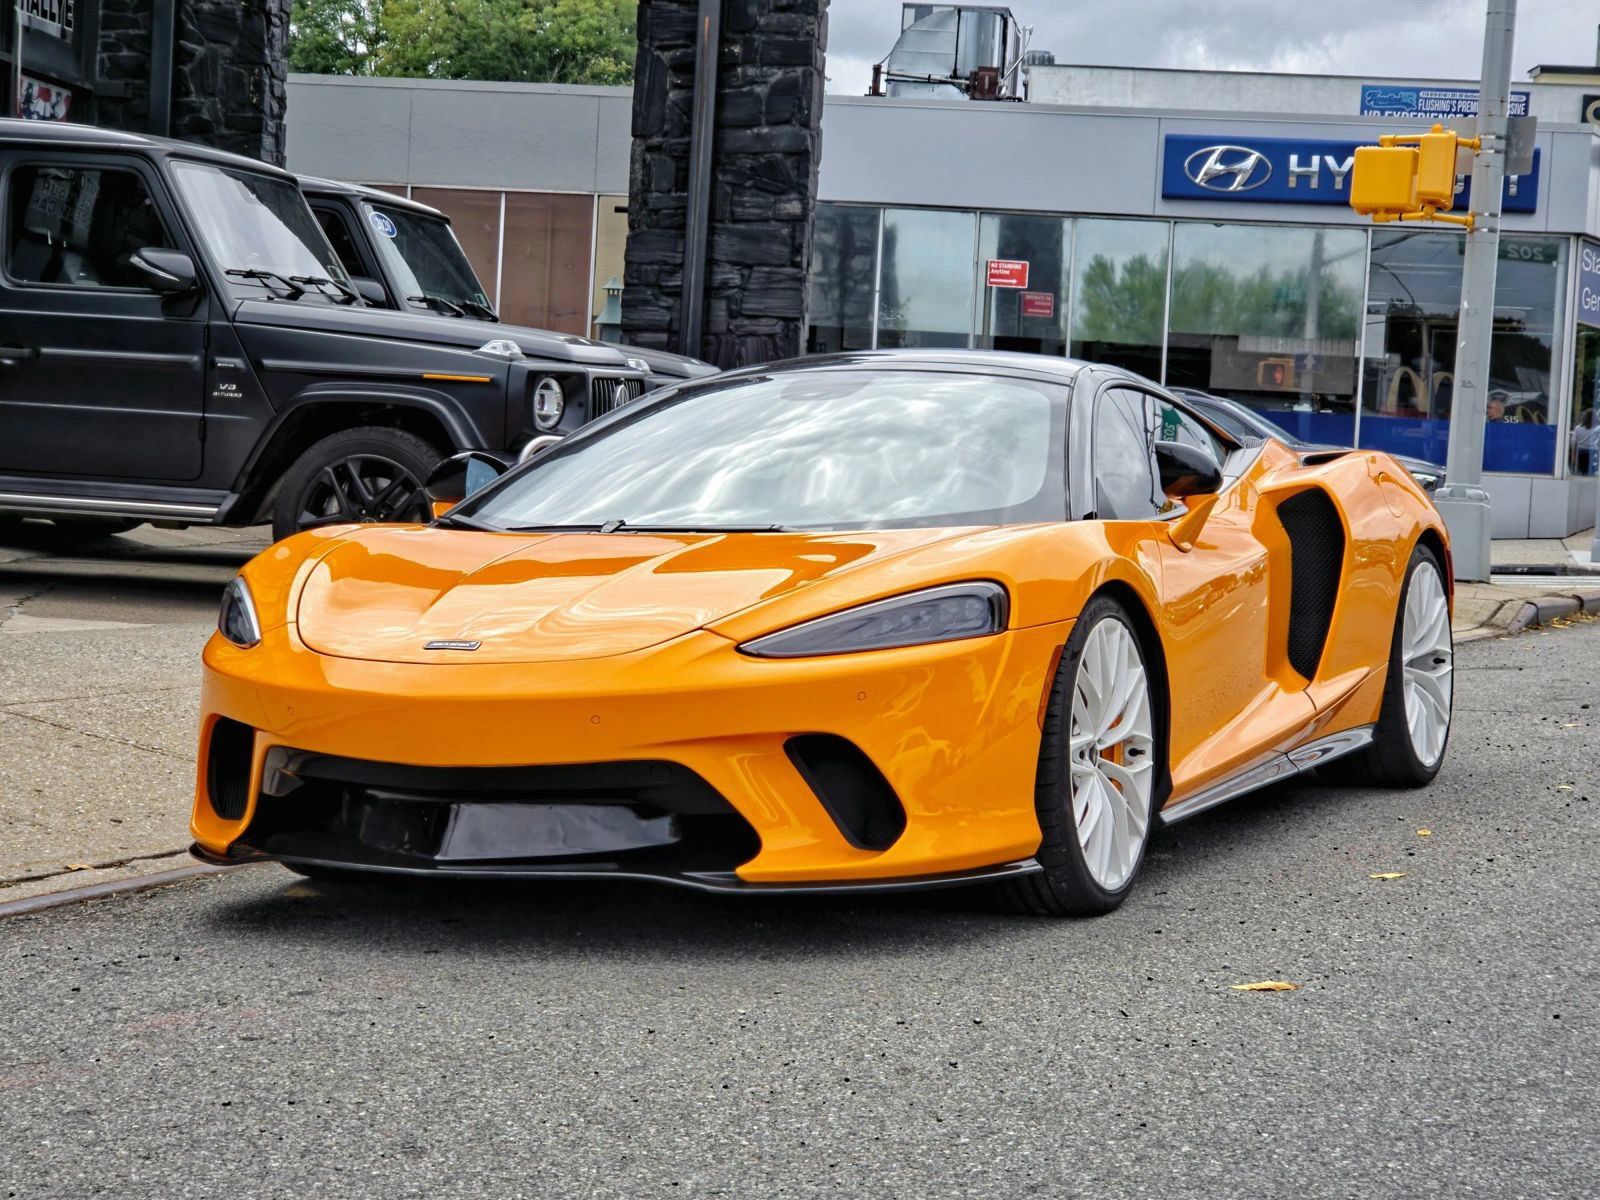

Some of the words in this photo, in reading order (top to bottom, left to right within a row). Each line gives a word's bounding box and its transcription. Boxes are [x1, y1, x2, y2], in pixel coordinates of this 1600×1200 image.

[18, 0, 73, 29] ALLYE
[1418, 99, 1456, 112] FLUSHING'S
[1457, 102, 1479, 113] PREMI
